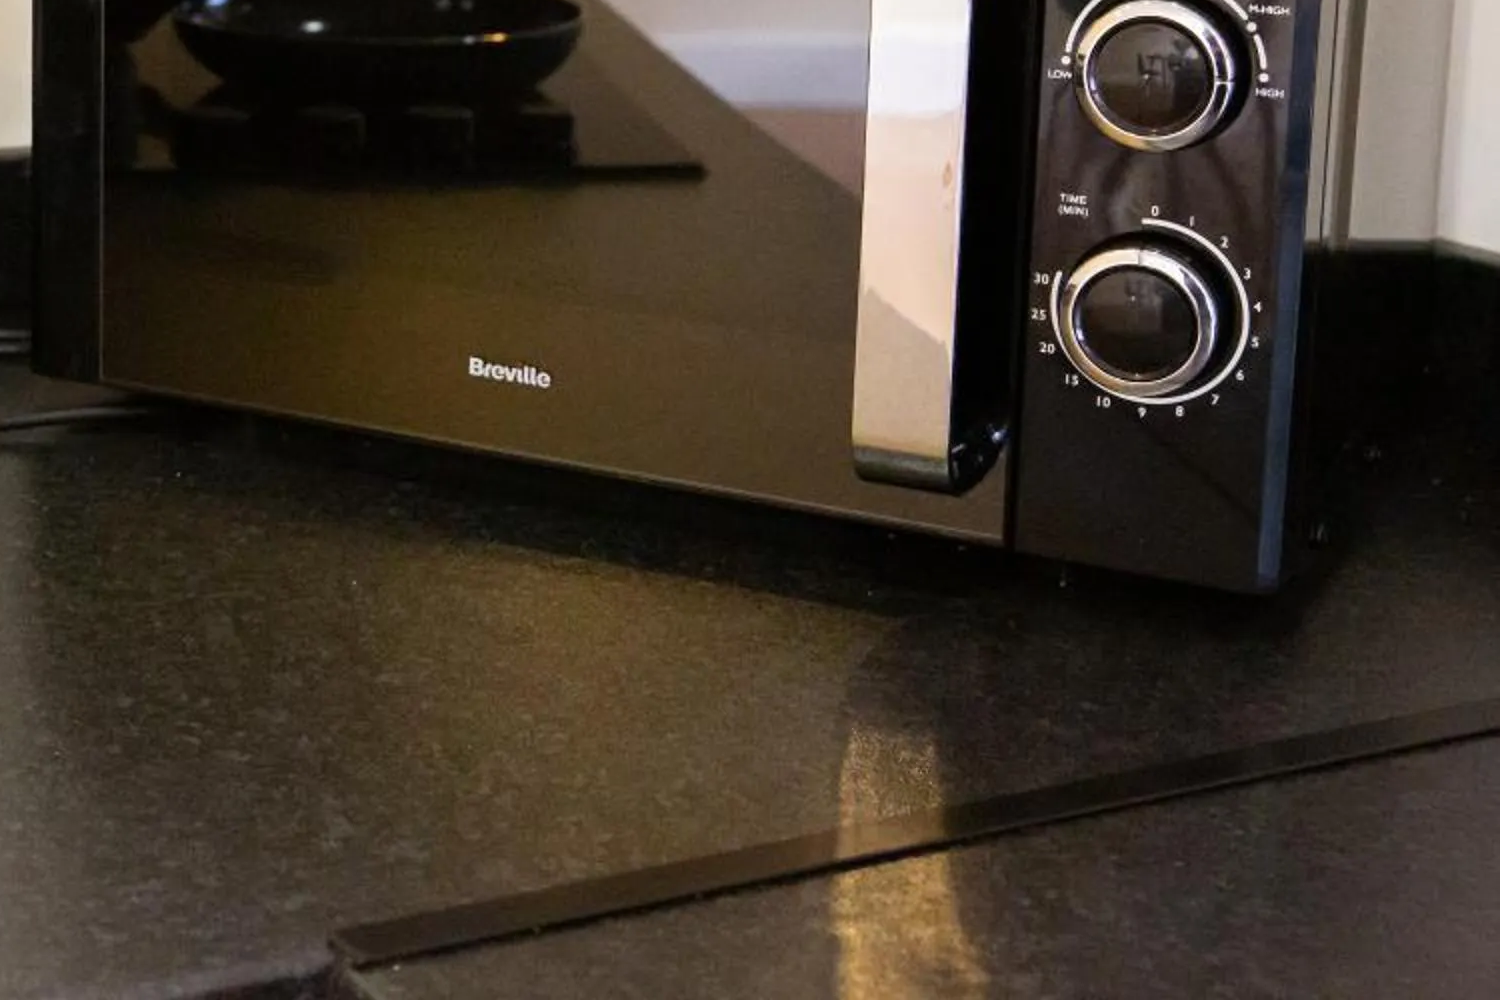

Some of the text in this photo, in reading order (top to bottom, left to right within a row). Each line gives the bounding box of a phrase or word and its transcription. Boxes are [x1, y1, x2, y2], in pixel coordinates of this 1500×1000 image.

[1047, 69, 1072, 80] LOW
[1255, 88, 1285, 99] HIGH
[1060, 193, 1087, 206] TIME
[1058, 205, 1089, 217] (MIN)
[1151, 205, 1160, 217] 0
[1189, 216, 1196, 227] 1
[1220, 236, 1230, 249] 2
[1033, 273, 1049, 285] 30
[1243, 268, 1251, 280] 3
[1253, 301, 1262, 313] 4
[1031, 308, 1047, 321] 25
[1251, 336, 1260, 348] 5
[1039, 342, 1055, 355] 20
[468, 356, 551, 389] Breville
[1235, 370, 1245, 381] 6
[1065, 374, 1079, 387] 15
[1096, 396, 1111, 408] 10
[1211, 394, 1219, 406] 7
[1138, 407, 1147, 419] 9
[1175, 406, 1184, 417] 8
